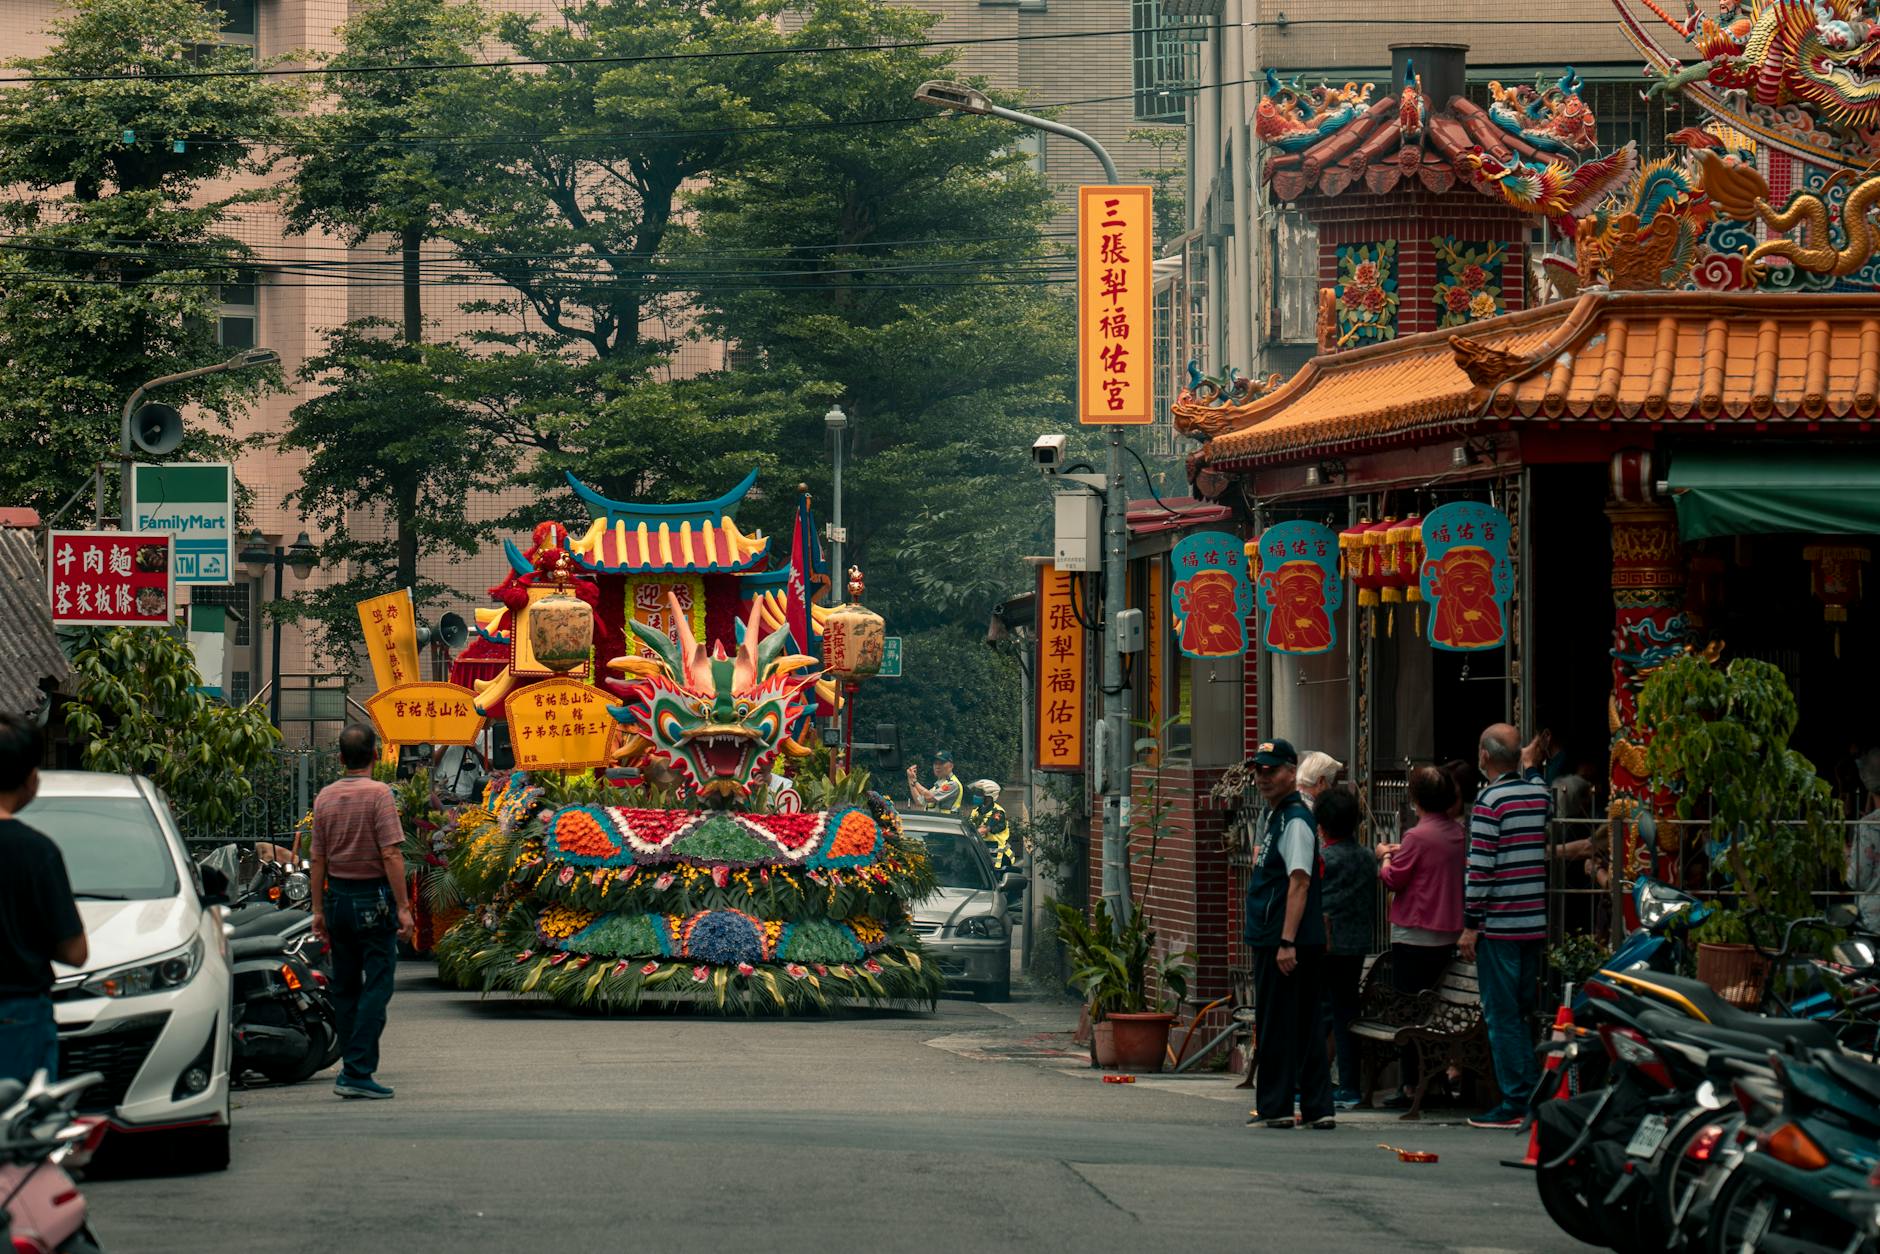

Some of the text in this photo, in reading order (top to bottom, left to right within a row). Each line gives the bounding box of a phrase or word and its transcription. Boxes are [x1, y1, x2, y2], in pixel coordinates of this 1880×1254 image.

[1099, 198, 1130, 412] 三張犁福佑宮
[139, 514, 226, 532] FamilyMart
[1431, 521, 1498, 543] 福佑宮
[1182, 550, 1240, 567] 福佑宮
[1268, 539, 1329, 557] 福佑宮
[56, 543, 133, 577] 牛肉麵
[1046, 575, 1076, 758] 三張犁福佑宮
